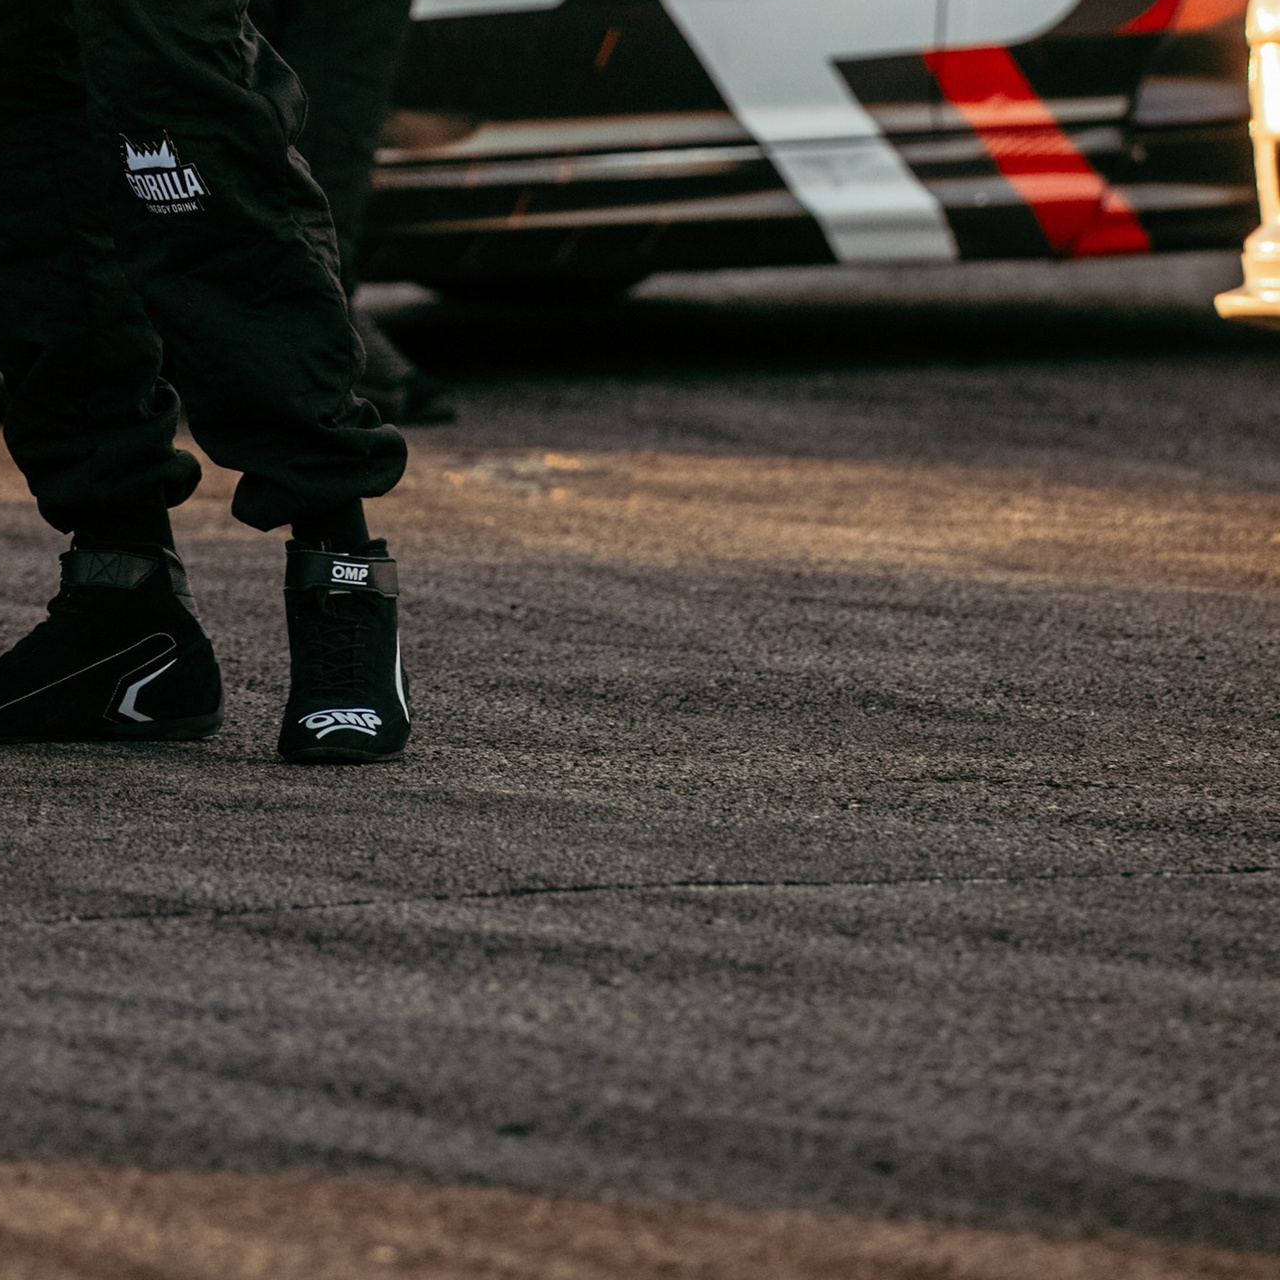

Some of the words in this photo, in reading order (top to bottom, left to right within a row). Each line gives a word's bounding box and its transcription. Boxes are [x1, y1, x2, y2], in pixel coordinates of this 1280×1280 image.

[125, 168, 205, 201] GORILLA
[171, 201, 199, 214] DRINK
[331, 565, 369, 581] OMP
[305, 711, 383, 731] OMP
